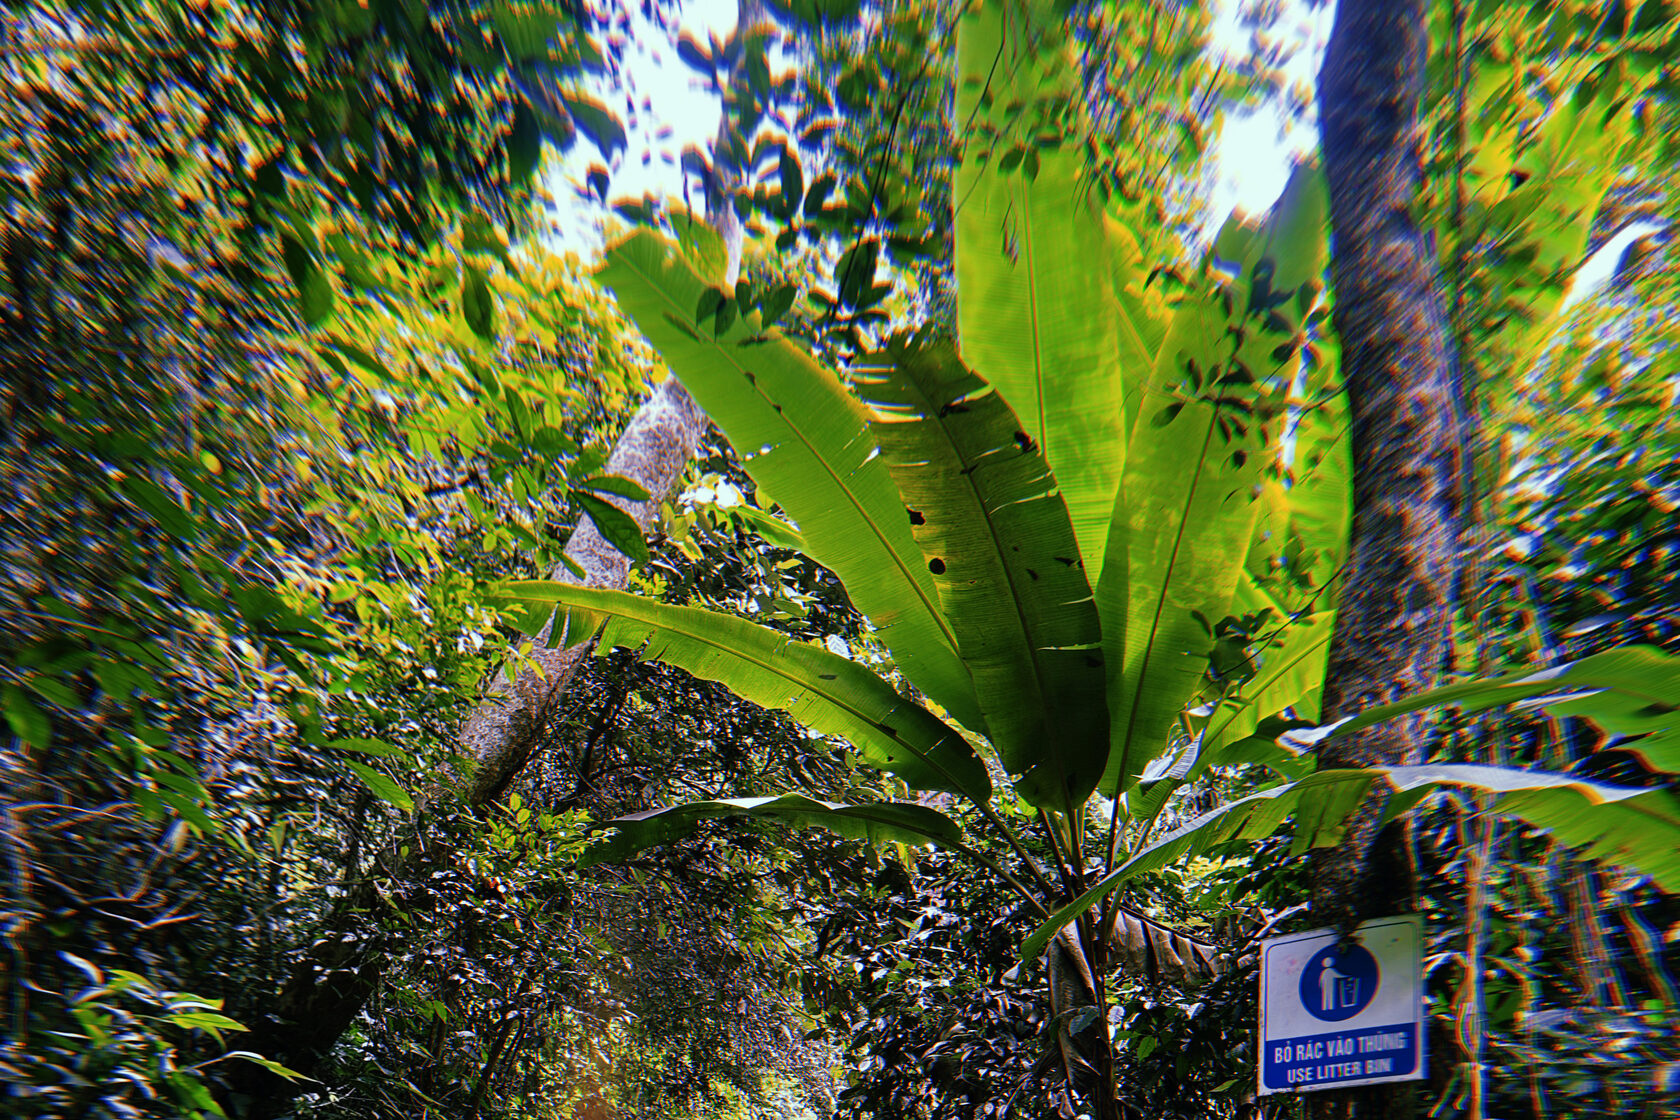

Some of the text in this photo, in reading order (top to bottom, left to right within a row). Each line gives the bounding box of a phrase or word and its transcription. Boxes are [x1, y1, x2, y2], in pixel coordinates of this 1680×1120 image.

[1274, 1031, 1406, 1064] BỎ RÁC VÀO THÙNG
[1287, 1058, 1393, 1083] USE LITTER BIN
